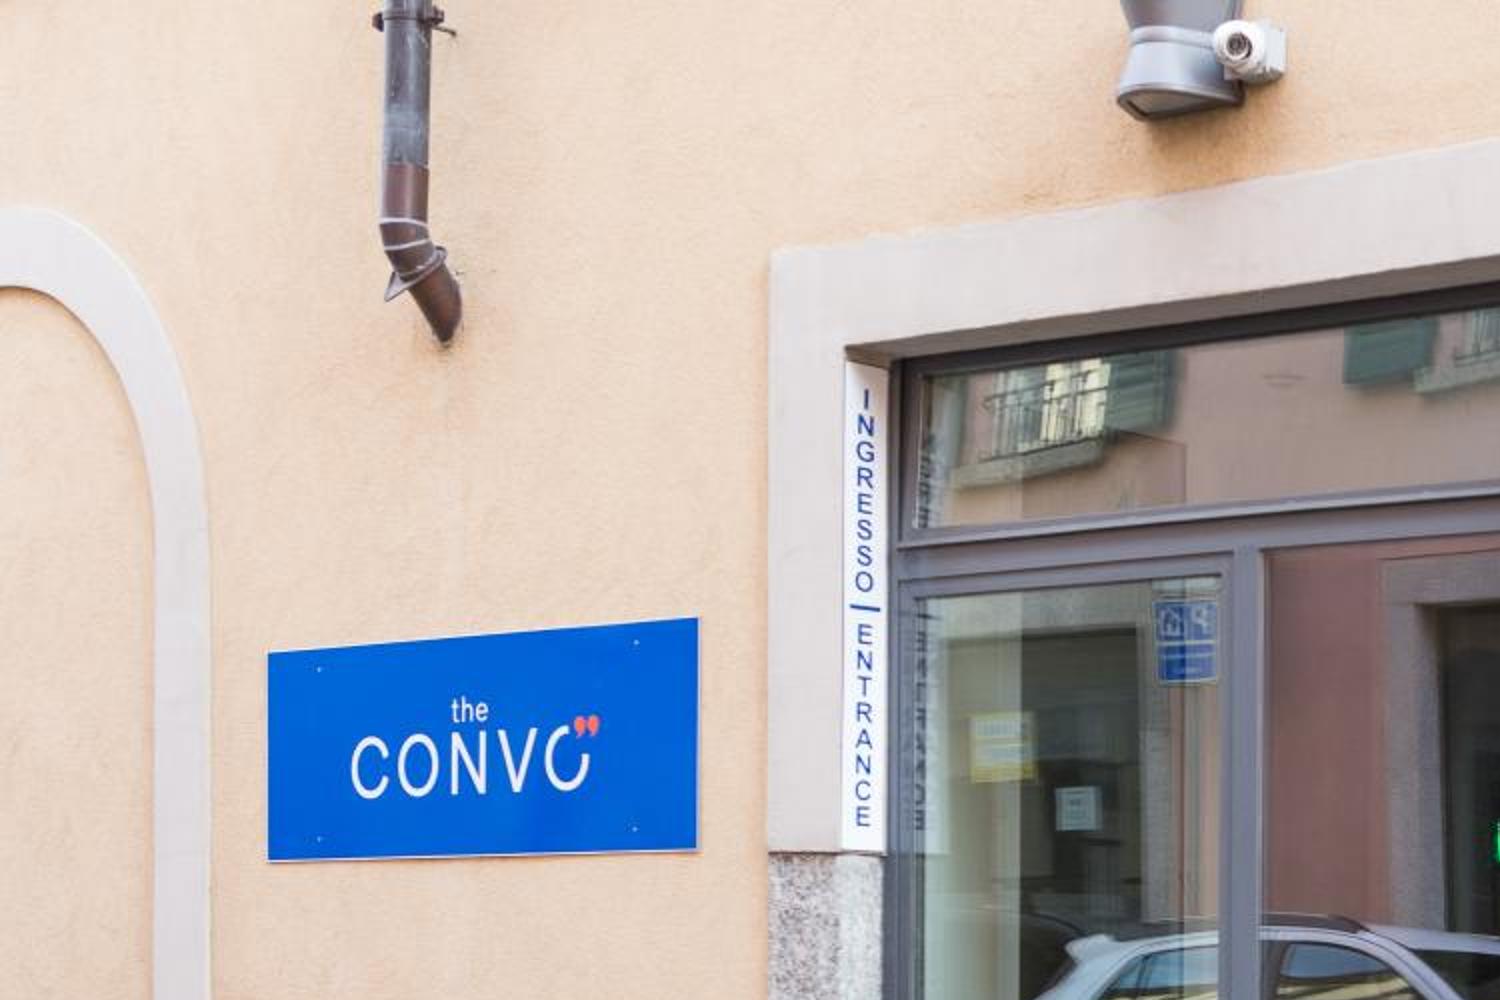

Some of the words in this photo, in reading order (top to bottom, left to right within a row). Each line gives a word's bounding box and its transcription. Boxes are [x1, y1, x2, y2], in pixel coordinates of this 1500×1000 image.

[855, 388, 875, 593] INGRESSO
[451, 695, 489, 722] the
[854, 623, 873, 828] ENTRANCE
